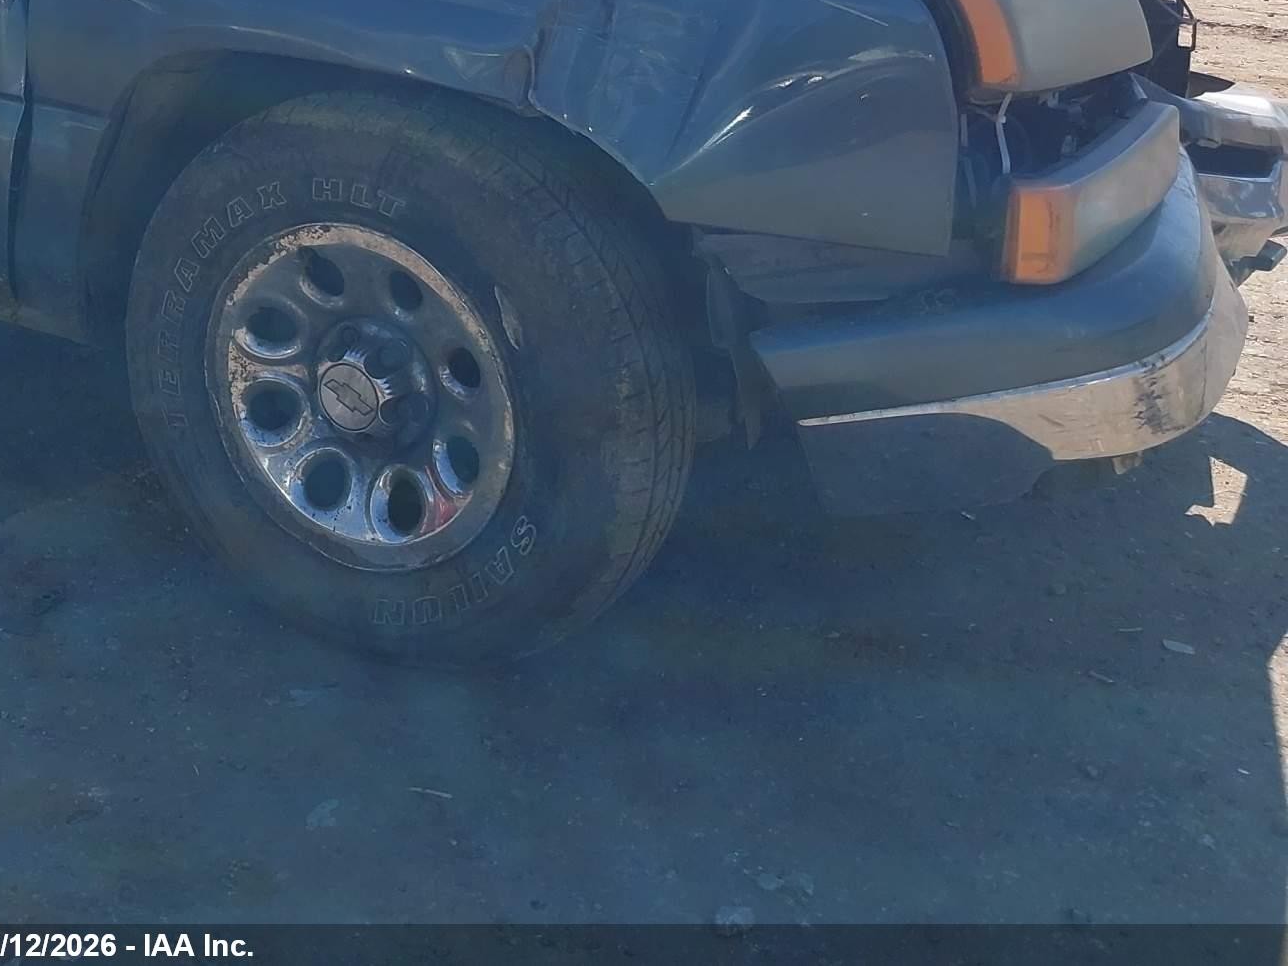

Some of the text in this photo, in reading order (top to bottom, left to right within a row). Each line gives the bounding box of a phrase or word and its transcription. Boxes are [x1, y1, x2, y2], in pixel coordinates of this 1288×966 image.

[158, 177, 407, 428] TERRAMAX HLT
[374, 514, 537, 626] SAILUN
